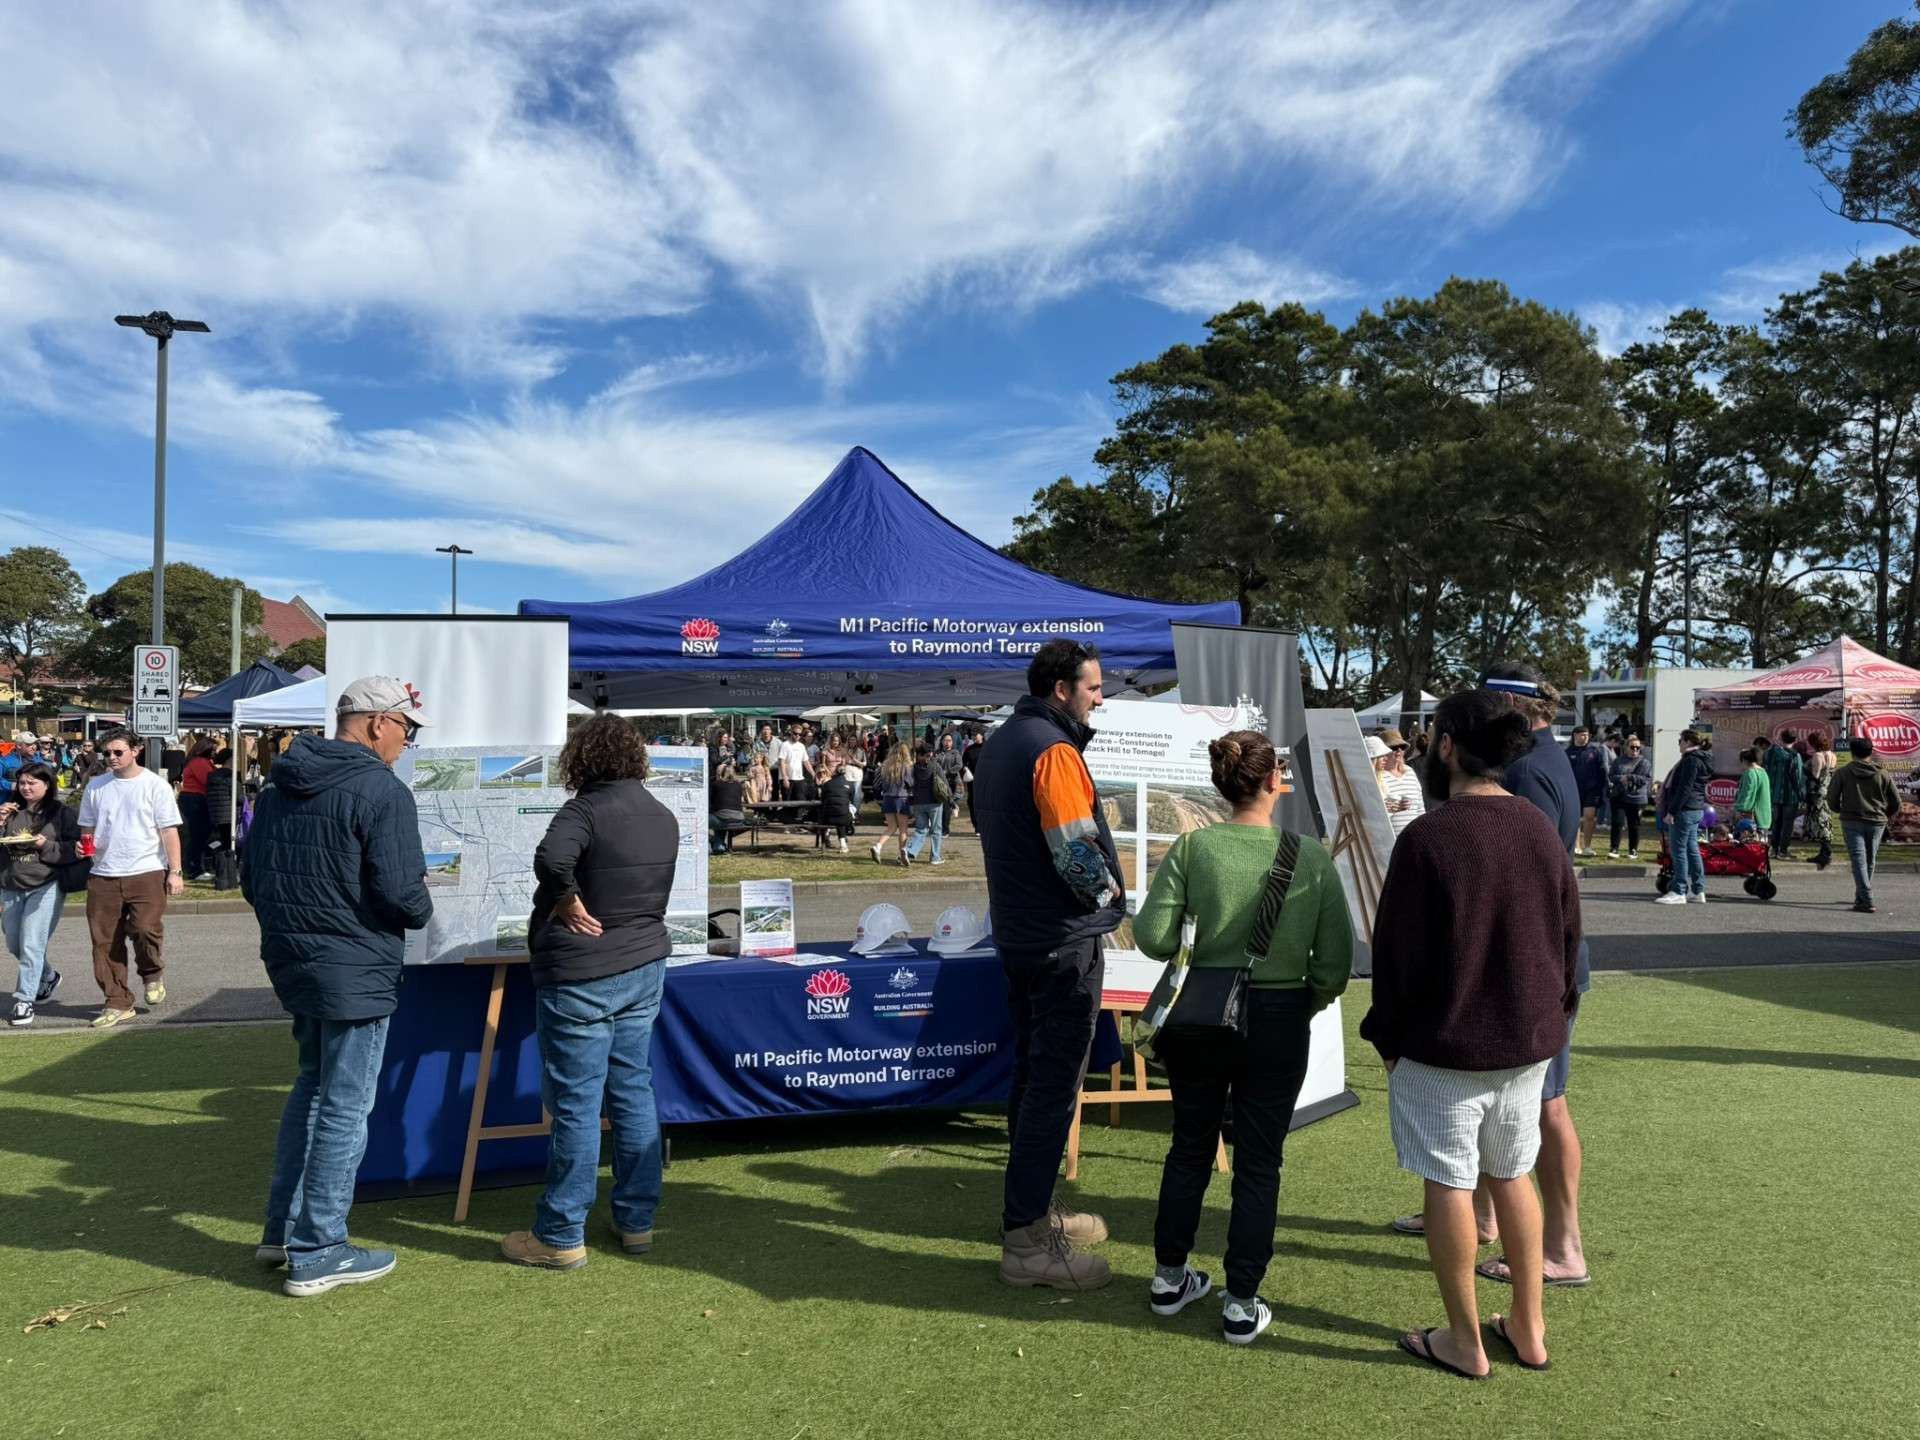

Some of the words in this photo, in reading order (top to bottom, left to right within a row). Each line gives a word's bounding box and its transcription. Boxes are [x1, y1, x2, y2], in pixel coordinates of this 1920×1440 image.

[840, 617, 864, 632] M1
[869, 617, 928, 632] Pacific
[932, 617, 1017, 635] Motorway
[1022, 619, 1104, 633] extension
[682, 641, 718, 653] NSW
[889, 640, 907, 653] to
[912, 638, 992, 656] Raymond
[997, 638, 1041, 653] Terra
[150, 657, 160, 665] 10
[1097, 729, 1123, 737] torway
[1125, 731, 1162, 740] extension
[1119, 738, 1169, 748] Construction
[807, 998, 849, 1014] NSW
[807, 1012, 849, 1020] GOVERNMENT
[735, 1053, 758, 1068] M1
[764, 1049, 823, 1067] Pacific
[827, 1047, 912, 1062] Motorway
[916, 1040, 997, 1057] extension
[784, 1074, 802, 1088] to
[806, 1067, 887, 1088] Raymond
[891, 1066, 955, 1081] Terrace
